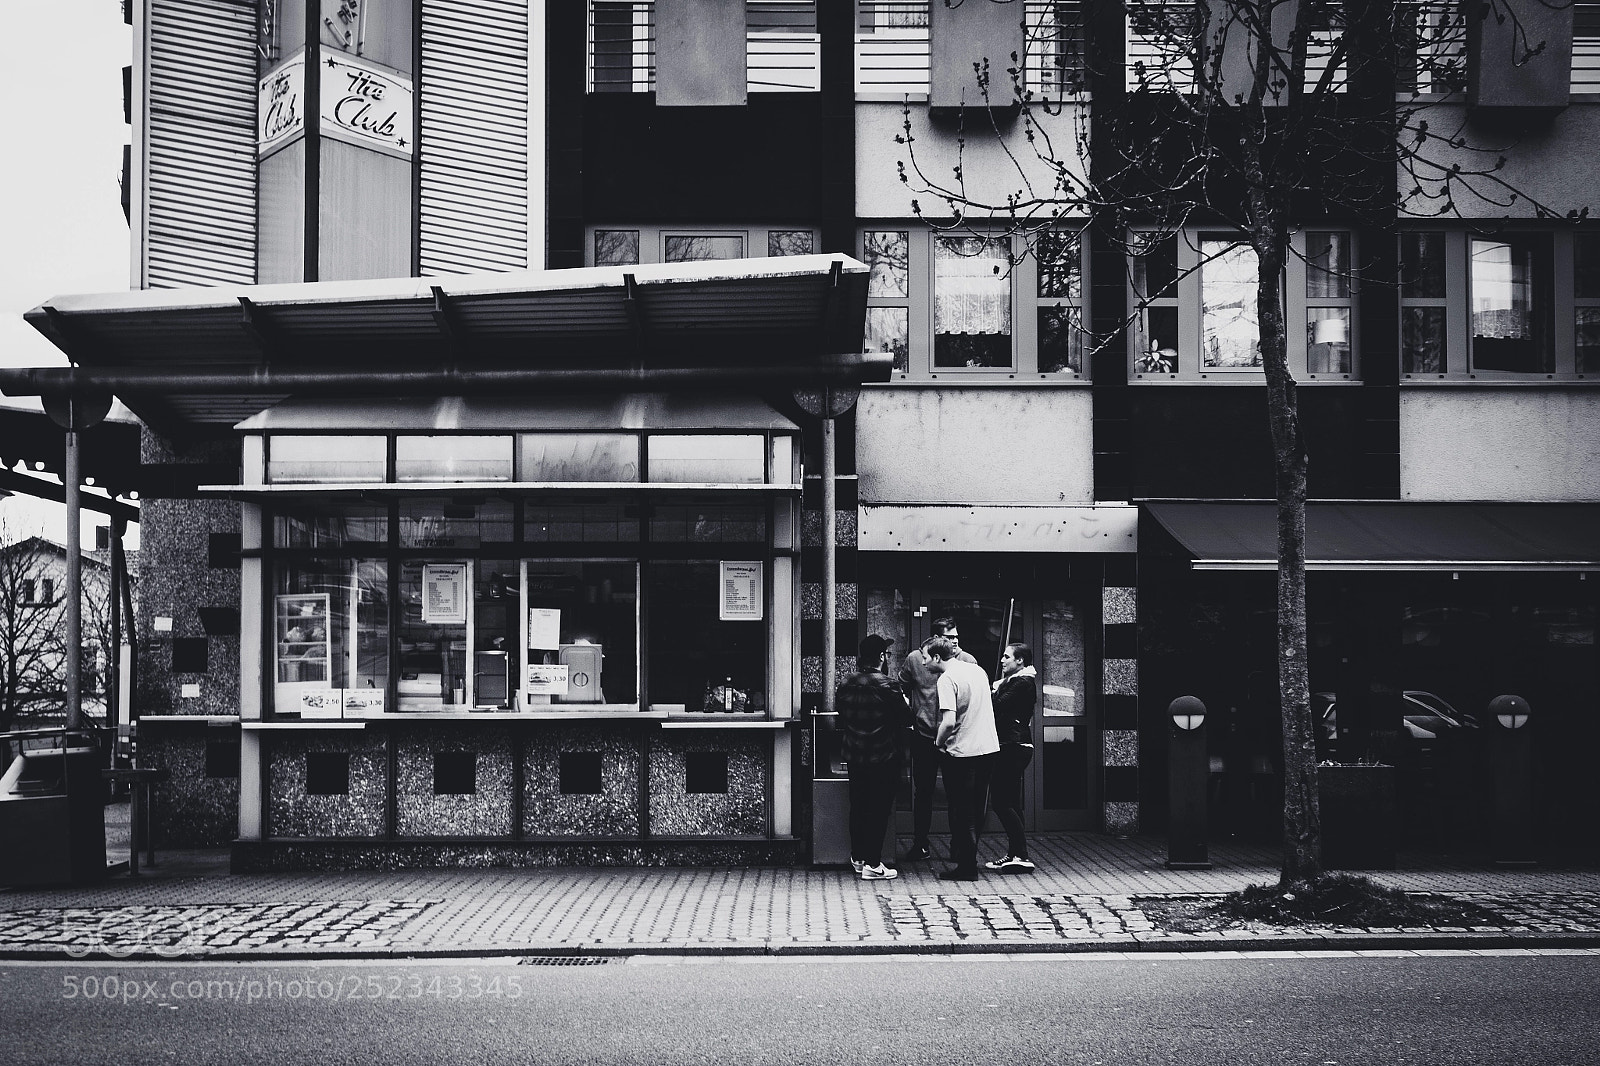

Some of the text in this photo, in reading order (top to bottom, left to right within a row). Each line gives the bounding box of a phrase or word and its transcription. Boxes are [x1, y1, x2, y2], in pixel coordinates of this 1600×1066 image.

[346, 71, 387, 101] The
[264, 93, 297, 139] Club
[334, 95, 397, 136] Club
